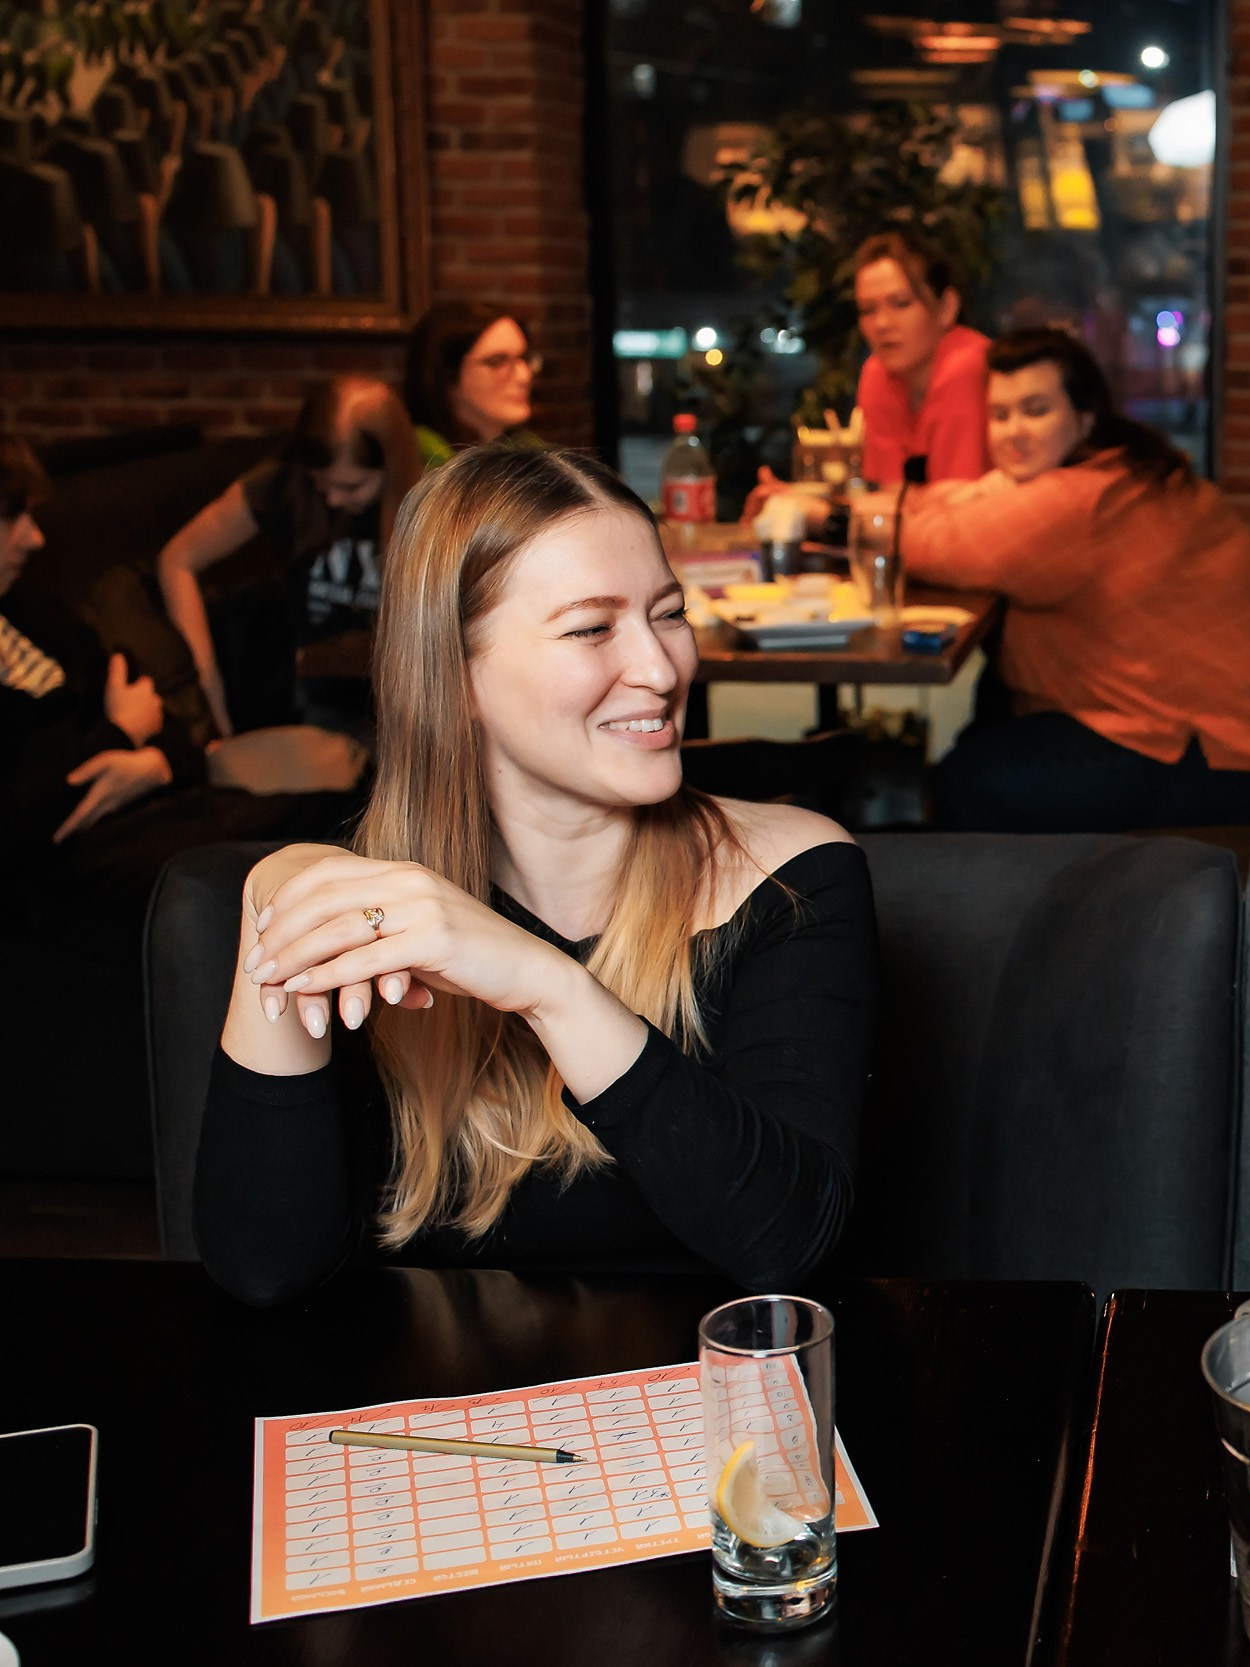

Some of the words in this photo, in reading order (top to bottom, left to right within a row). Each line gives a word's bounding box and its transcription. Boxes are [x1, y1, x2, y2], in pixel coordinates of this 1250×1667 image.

[635, 1537, 679, 1549] ТРЕТИЙ
[554, 1545, 623, 1562] ЧЕТВЕРТЫЙ
[498, 1558, 542, 1571] ПЯТЫЙ
[432, 1567, 478, 1581] ШЕСТОЙ
[359, 1577, 416, 1593] СЕДЬМОЙ
[290, 1587, 345, 1602] ВОСЬМОЙ
